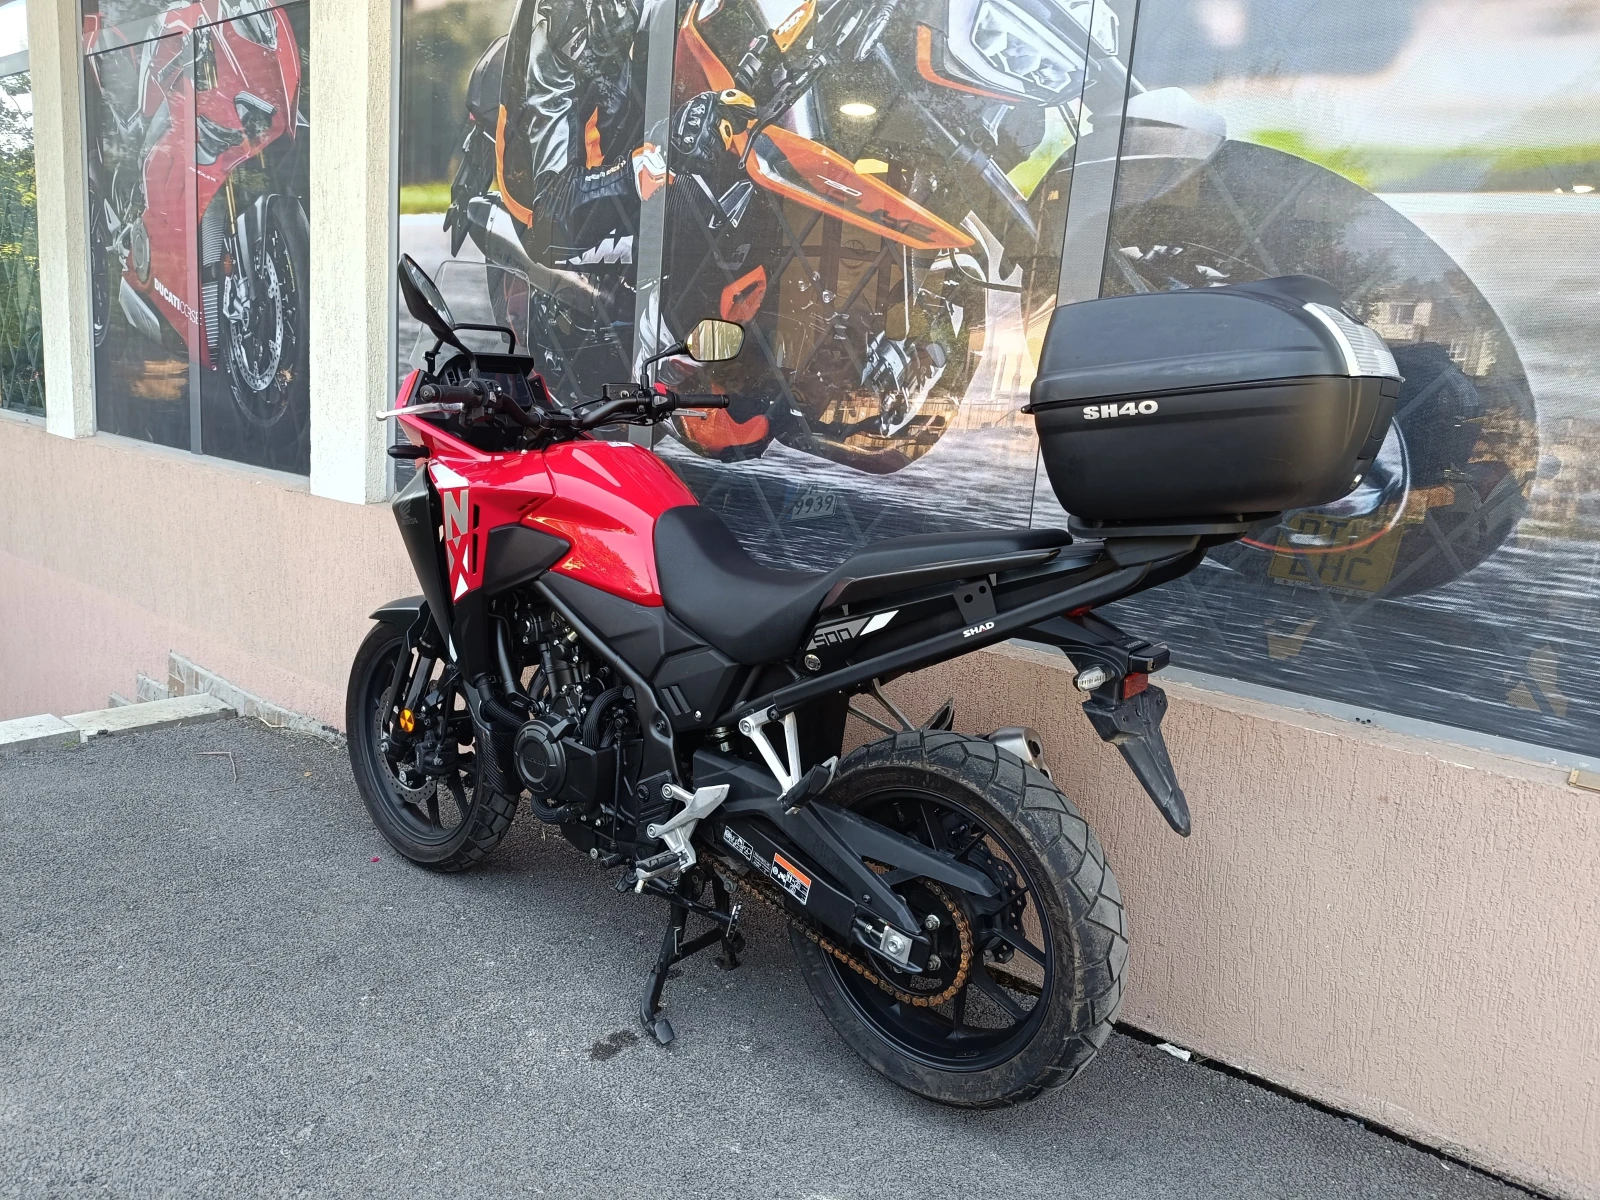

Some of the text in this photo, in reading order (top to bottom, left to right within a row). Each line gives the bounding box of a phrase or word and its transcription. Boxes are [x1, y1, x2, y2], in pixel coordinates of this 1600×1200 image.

[1082, 399, 1159, 420] SH40
[795, 495, 834, 515] 9939
[962, 621, 996, 638] SHAD
